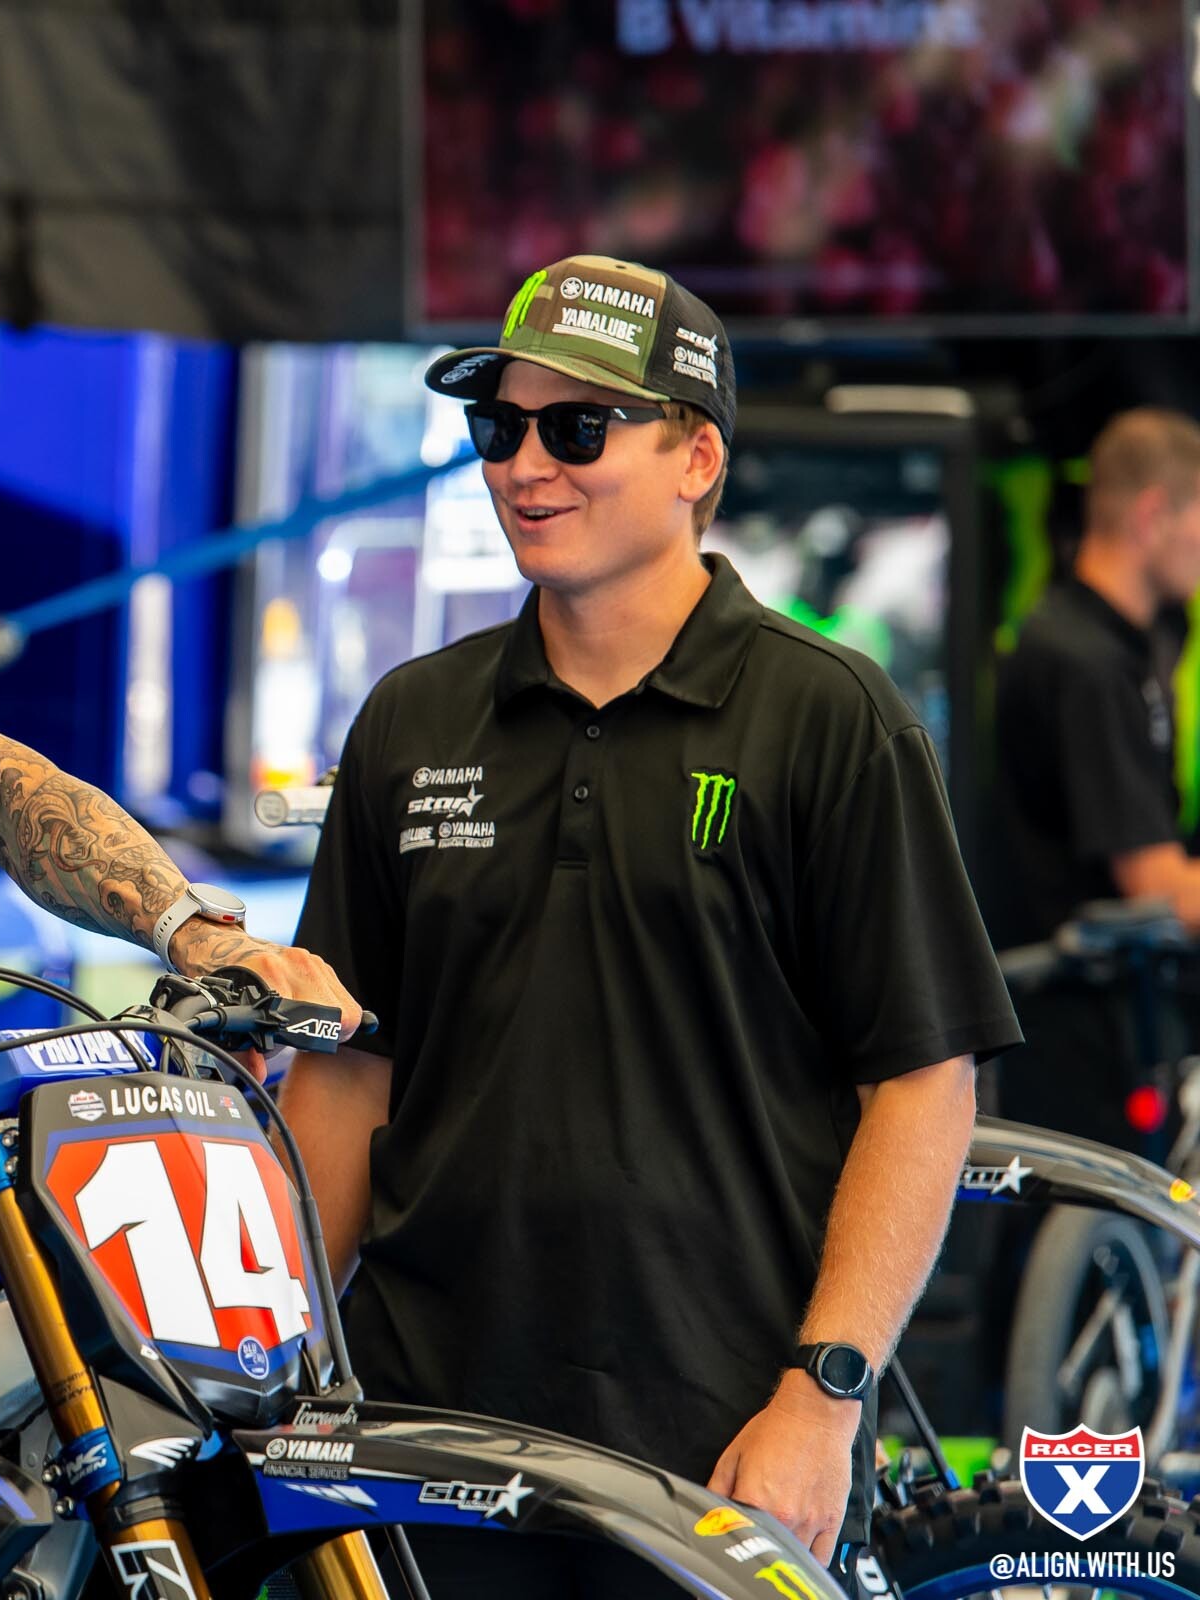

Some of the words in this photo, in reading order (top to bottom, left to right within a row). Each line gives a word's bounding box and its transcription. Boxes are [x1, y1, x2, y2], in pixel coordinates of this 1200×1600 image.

[583, 281, 656, 319] YAMAHA
[561, 306, 636, 343] YAMALUBE
[430, 766, 484, 785] YAMAHA
[452, 821, 496, 837] YAMAHA
[286, 1018, 341, 1040] ARC
[110, 1085, 184, 1116] LUCAS
[184, 1090, 217, 1118] OIL
[74, 1139, 310, 1349] 14
[286, 1440, 355, 1463] YAMAHA
